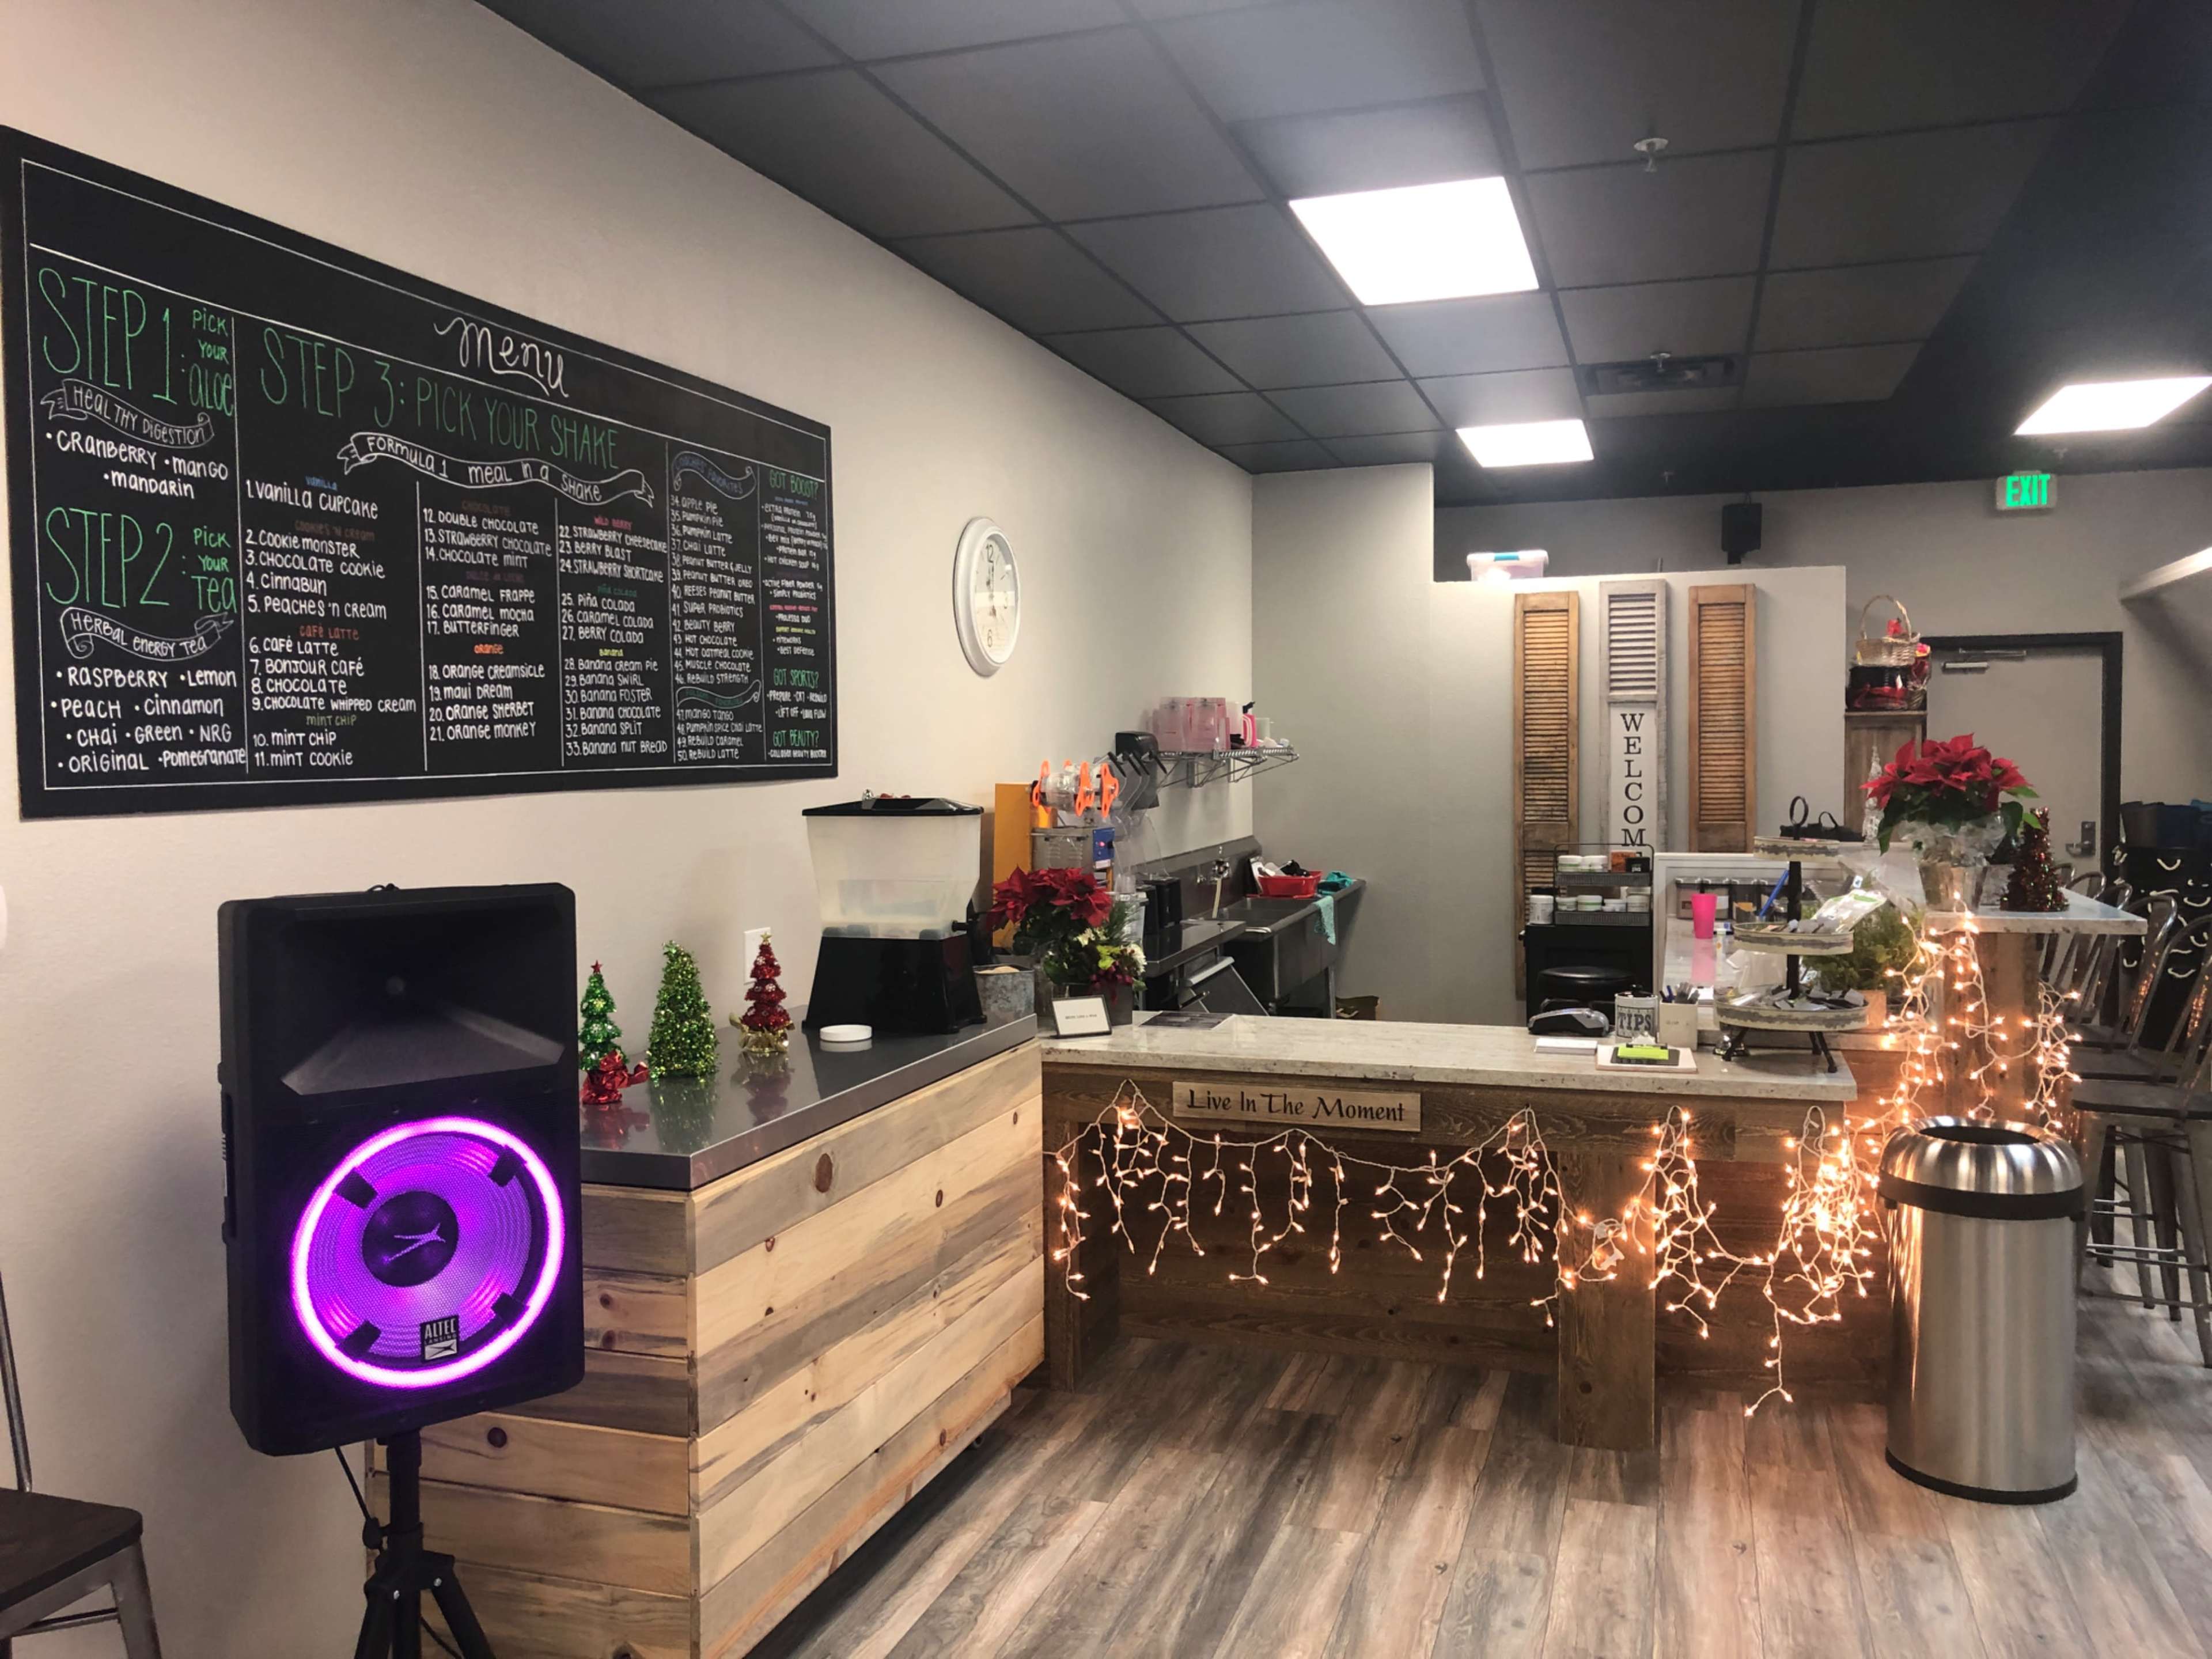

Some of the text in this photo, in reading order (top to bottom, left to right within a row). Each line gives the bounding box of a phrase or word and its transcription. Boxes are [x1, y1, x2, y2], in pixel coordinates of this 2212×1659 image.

[39, 268, 146, 390] STEP
[433, 317, 569, 398] Menu
[260, 327, 354, 418] STEP
[416, 377, 477, 441] PICK
[484, 396, 540, 452] YOUR
[550, 414, 620, 469] SHAKE
[439, 460, 449, 478] 1
[2006, 474, 2051, 507] EXIT
[46, 507, 143, 607] STEP
[199, 723, 232, 743] NRG
[1620, 713, 1646, 857] WELCOM
[1619, 1013, 1652, 1031] TIPS
[1187, 1089, 1405, 1122] Live In The Moment
[425, 1318, 456, 1339] ALTEC
